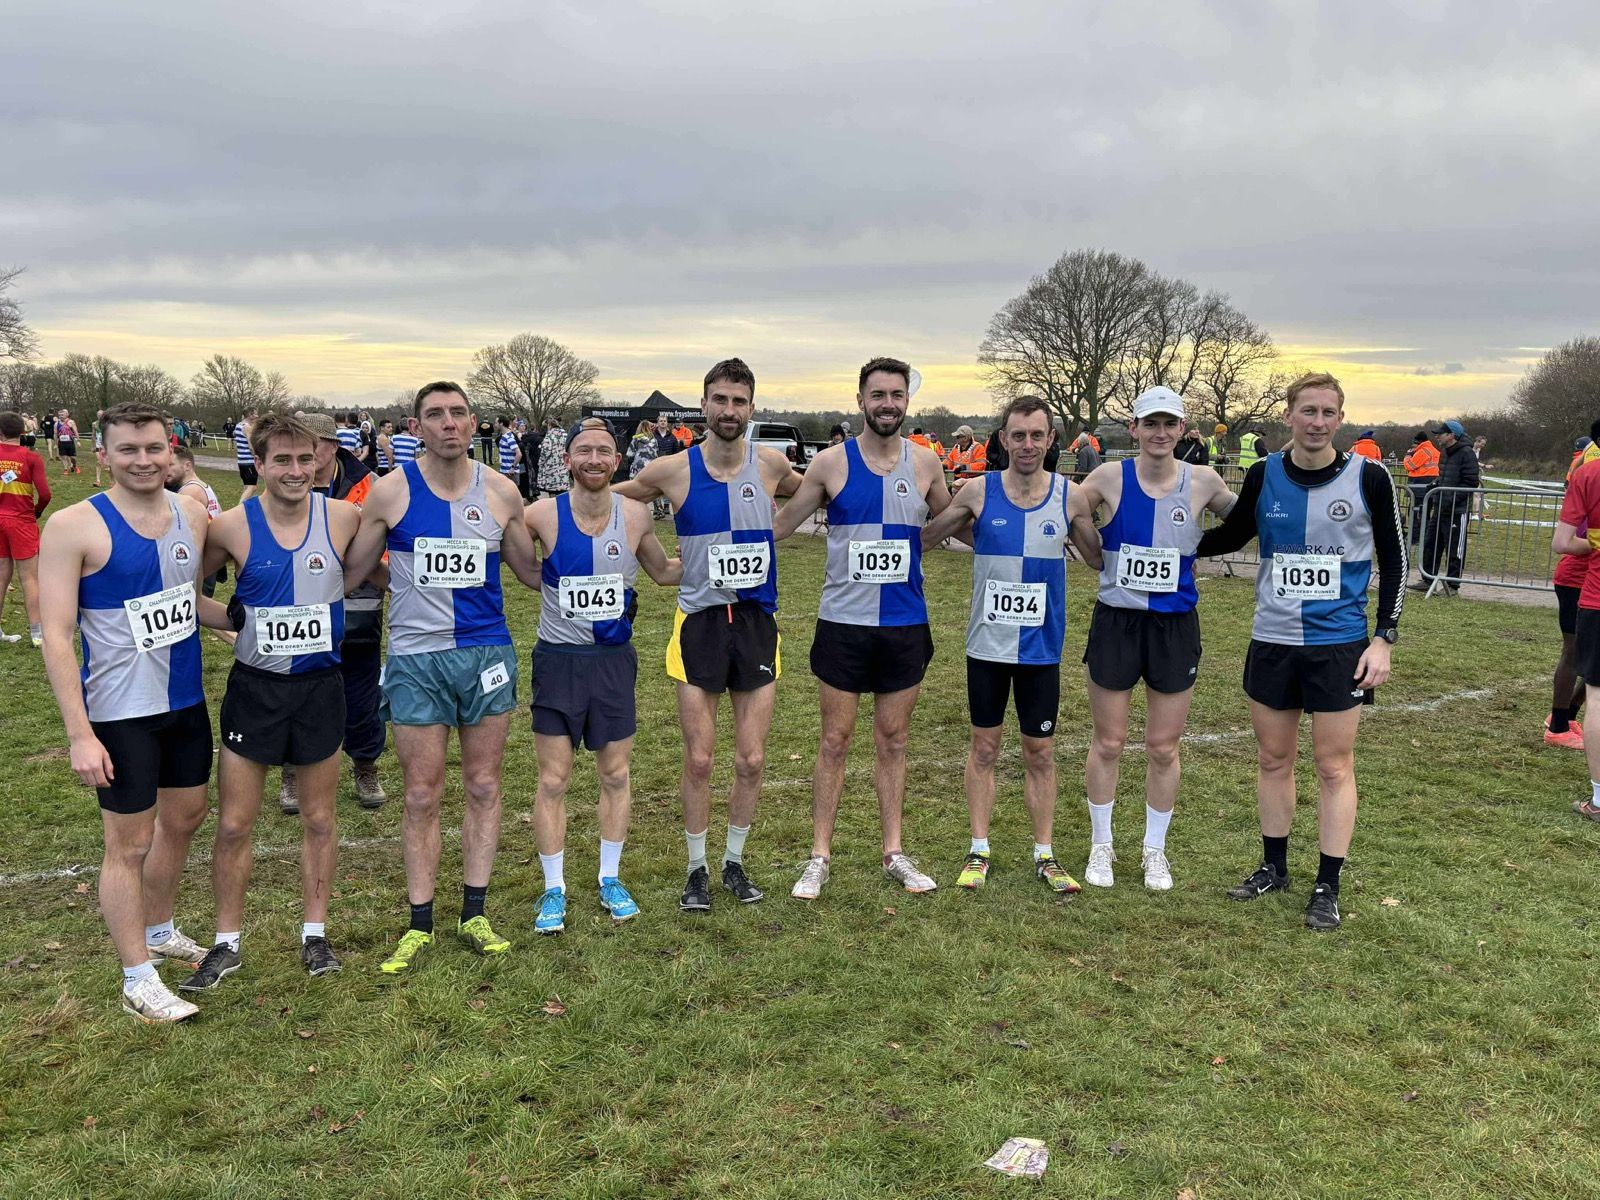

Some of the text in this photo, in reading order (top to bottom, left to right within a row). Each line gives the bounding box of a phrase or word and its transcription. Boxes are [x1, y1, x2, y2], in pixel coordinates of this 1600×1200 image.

[1326, 546, 1344, 555] AC
[424, 552, 476, 574] 1036
[718, 556, 763, 576] 1032
[858, 552, 902, 571] 1039
[1126, 558, 1171, 580] 1035
[1281, 567, 1330, 587] 1030
[149, 592, 183, 607] CHAMPIONSHIPS
[568, 588, 616, 609] 1043
[993, 594, 1038, 614] 1034
[141, 599, 193, 634] 1042
[166, 629, 183, 637] DERBY
[266, 619, 321, 641] 1040
[490, 674, 503, 686] 40
